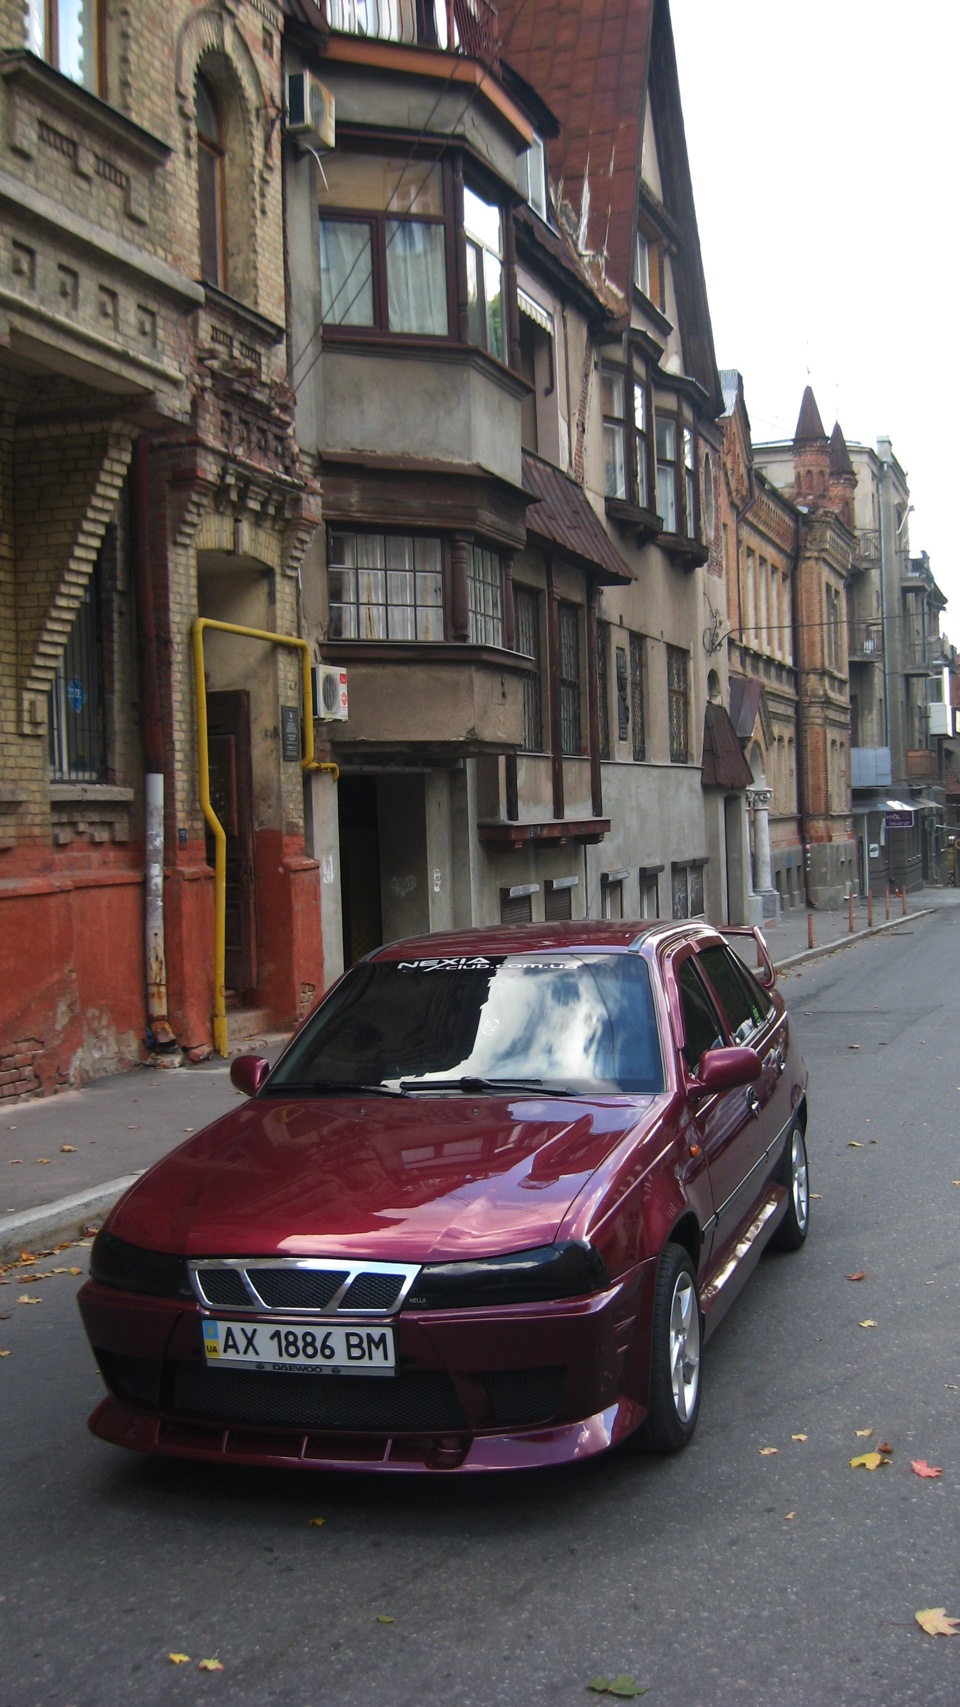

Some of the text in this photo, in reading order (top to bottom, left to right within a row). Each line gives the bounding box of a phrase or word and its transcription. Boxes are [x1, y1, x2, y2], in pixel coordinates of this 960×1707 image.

[397, 957, 490, 971] NEXIA
[206, 1345, 218, 1353] UA
[223, 1327, 388, 1361] AX 1886 BM
[273, 1364, 323, 1373] DAEWOO
